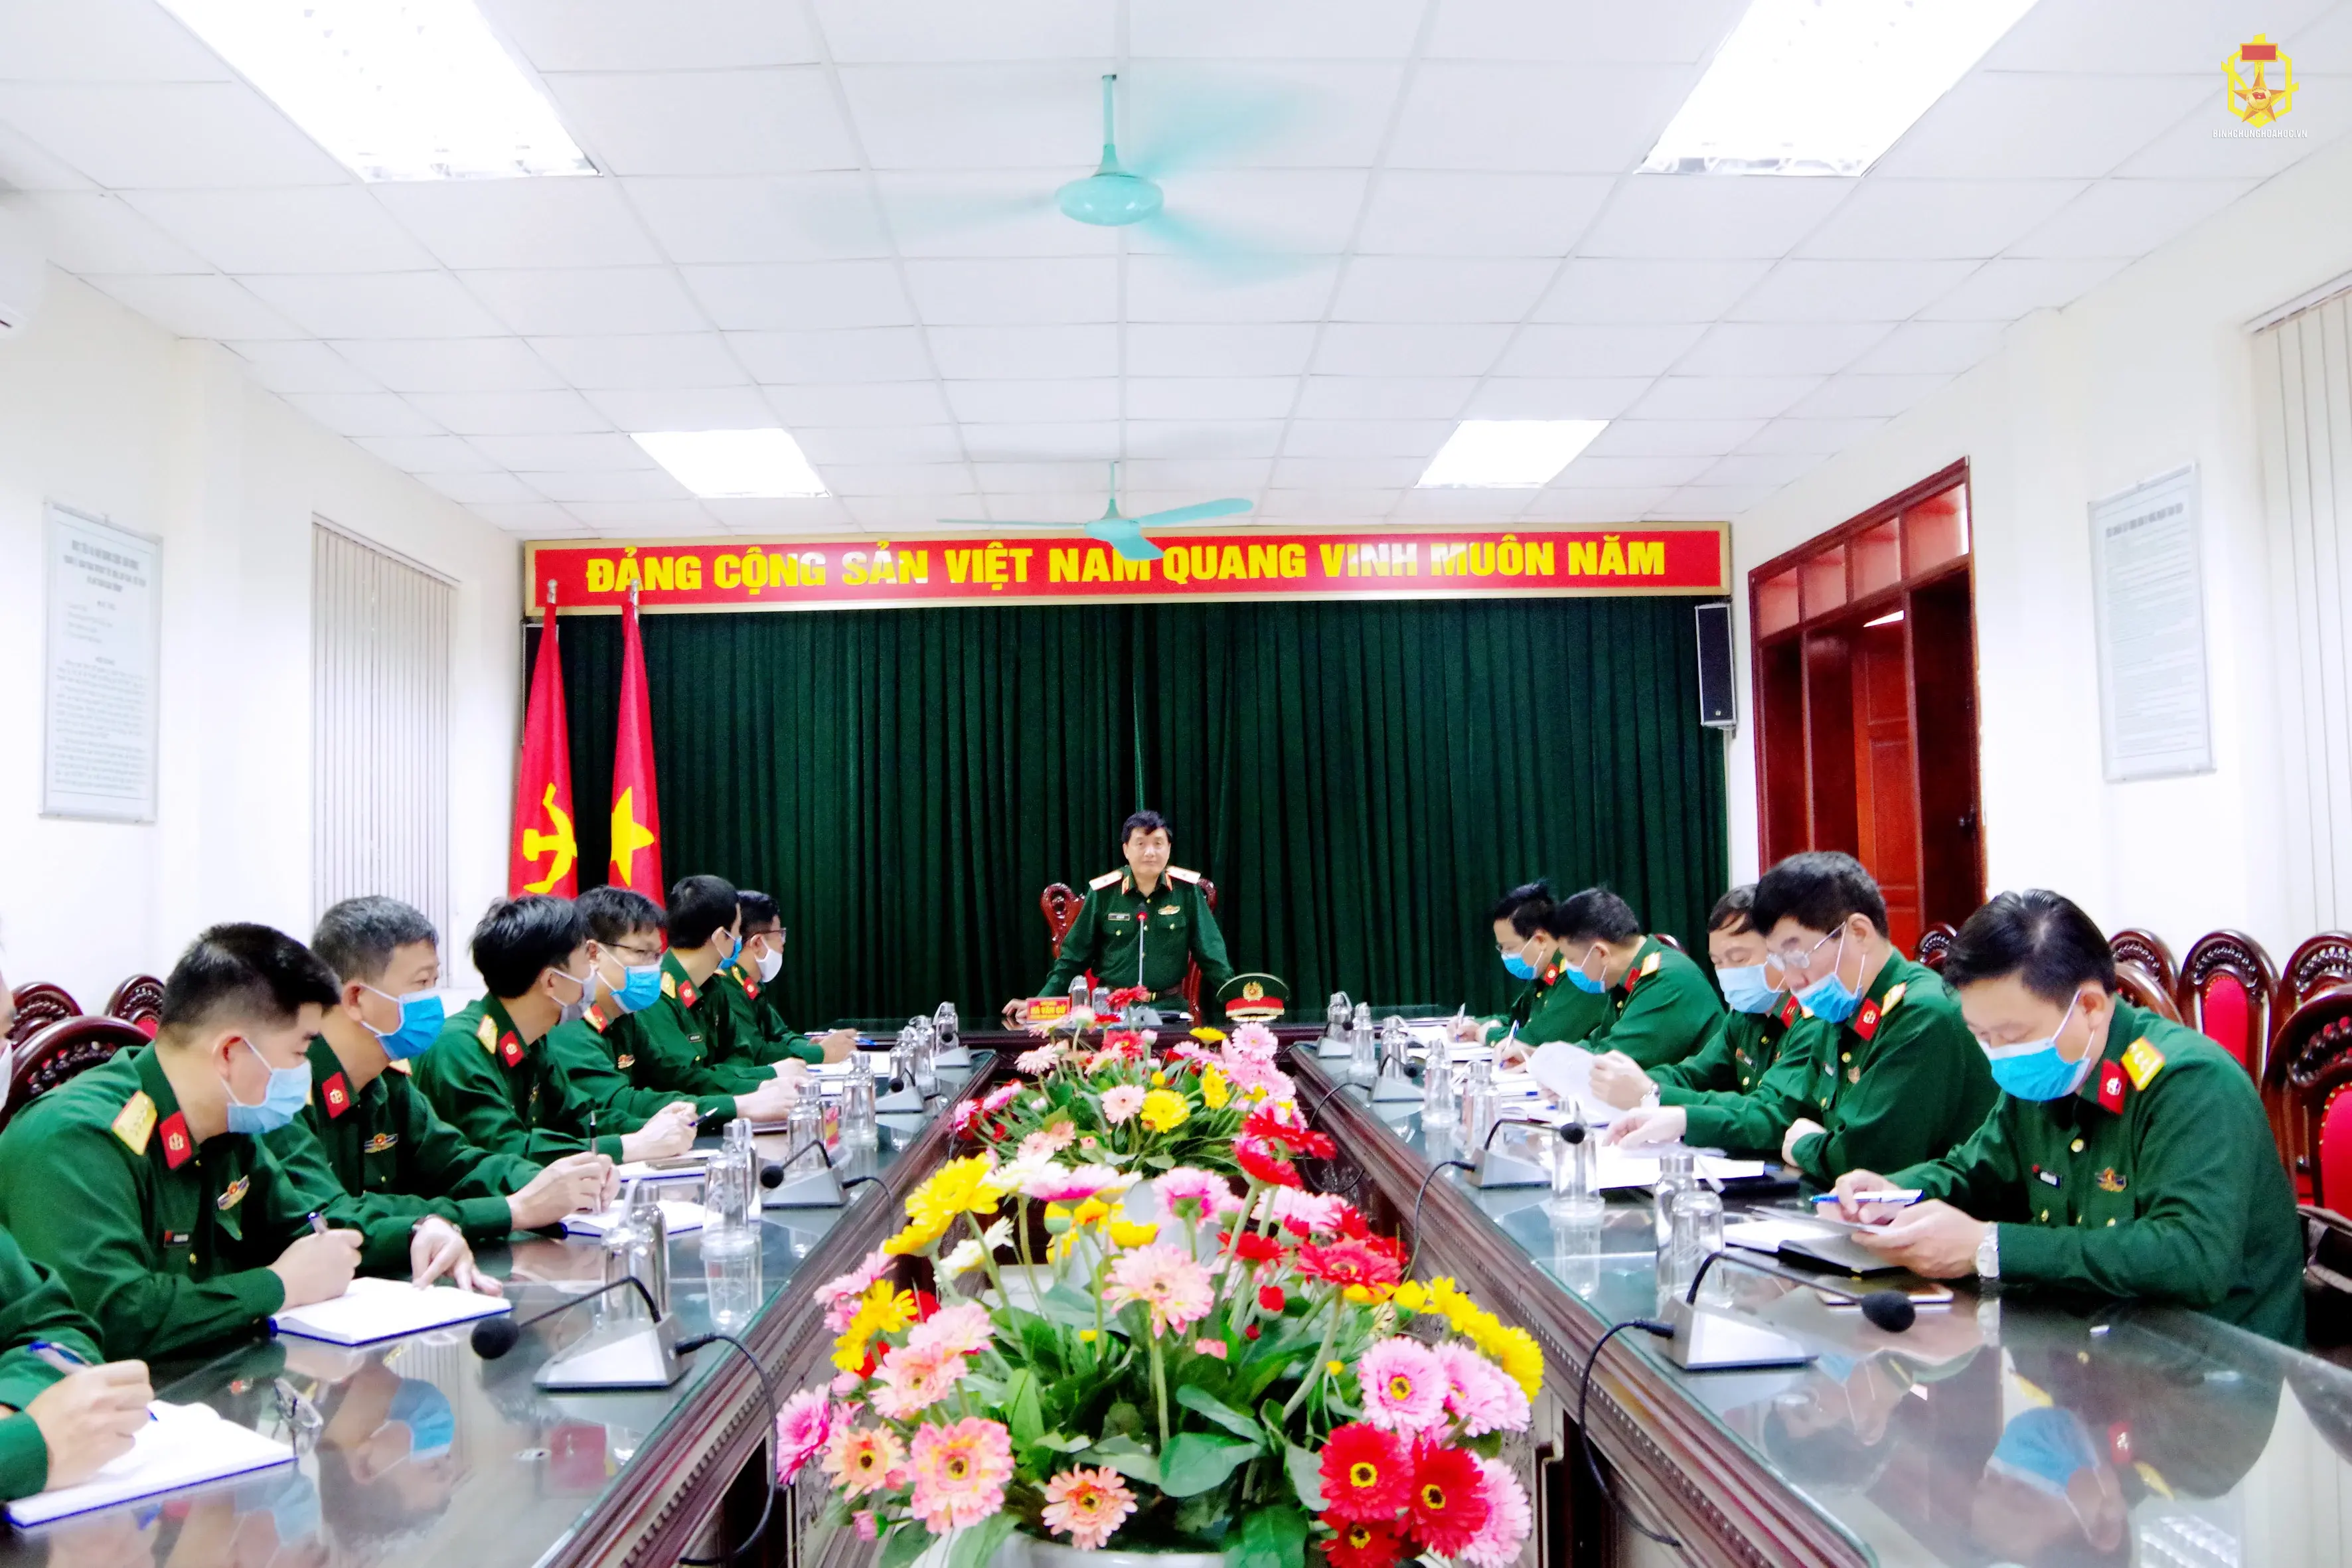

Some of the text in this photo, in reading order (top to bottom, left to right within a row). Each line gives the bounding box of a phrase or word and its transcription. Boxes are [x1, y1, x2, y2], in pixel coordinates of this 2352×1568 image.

[586, 545, 702, 592] ĐẢNG
[714, 546, 826, 595] CỘNG
[841, 540, 929, 586] SẢN
[943, 541, 1034, 591] VIỆT
[1162, 544, 1307, 585] QUANG
[1319, 542, 1418, 578] VINH
[1429, 533, 1555, 576] MUÔN
[1567, 534, 1666, 576] NĂM
